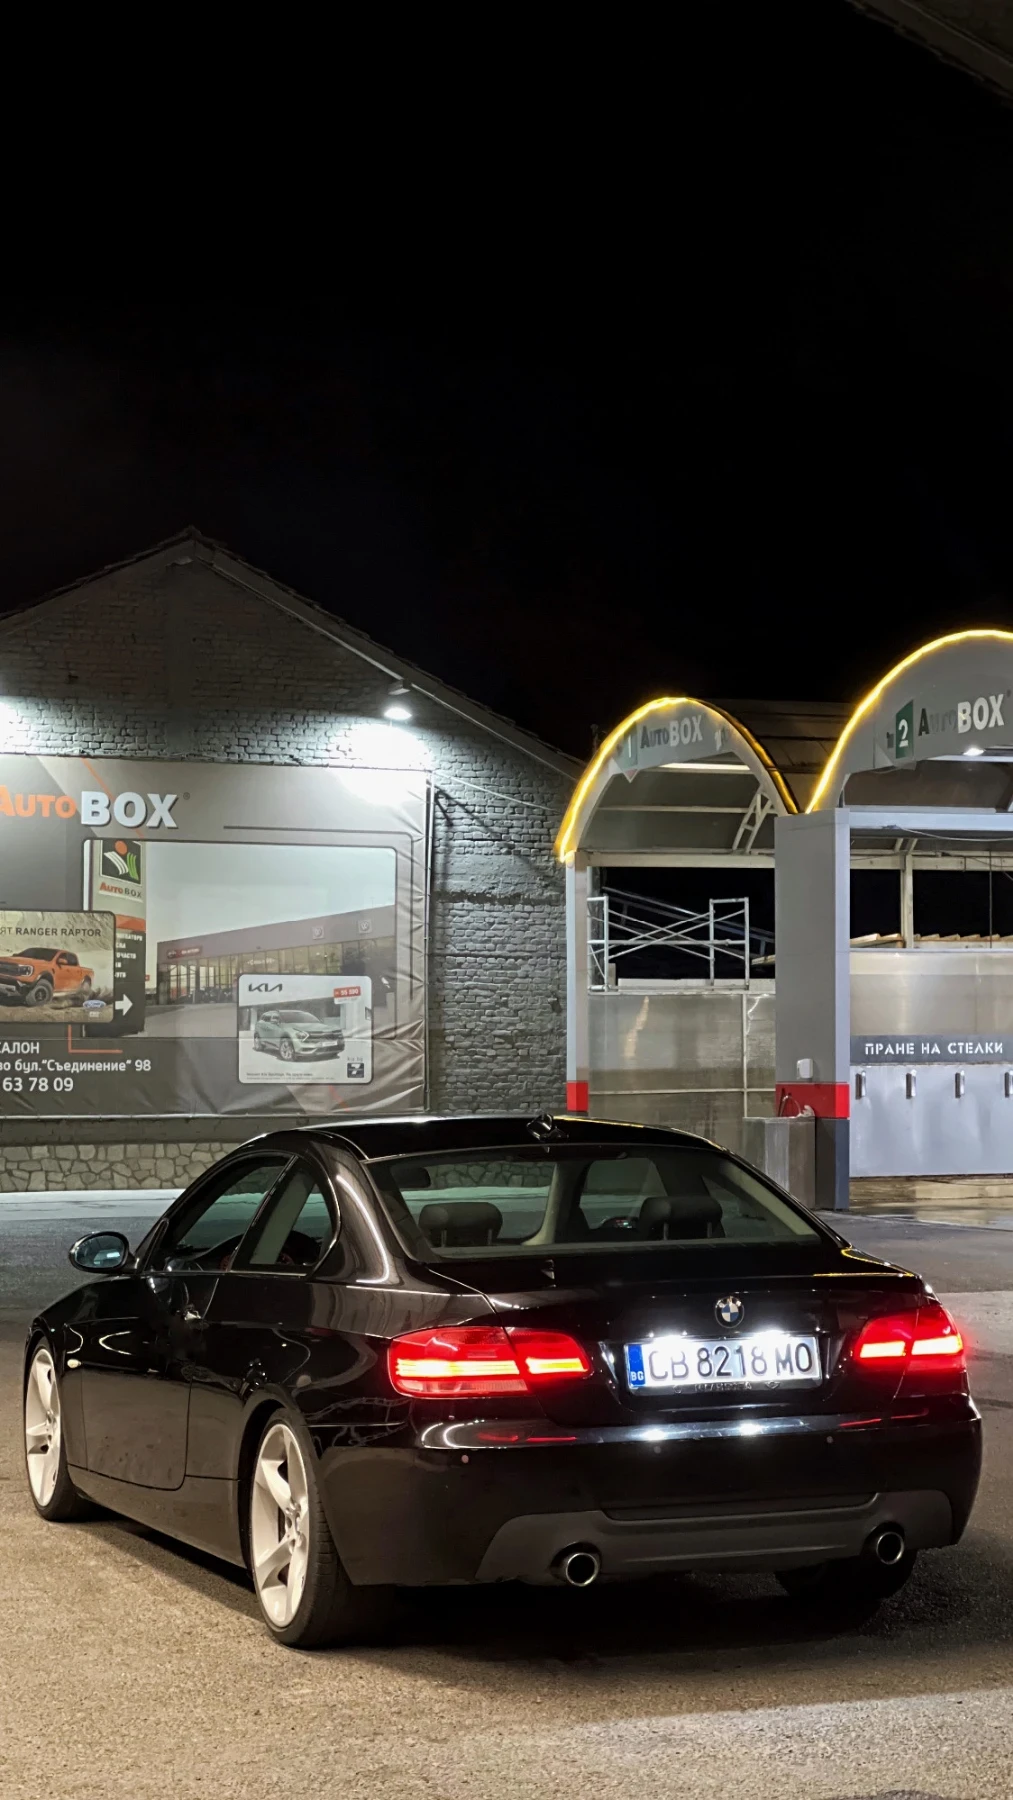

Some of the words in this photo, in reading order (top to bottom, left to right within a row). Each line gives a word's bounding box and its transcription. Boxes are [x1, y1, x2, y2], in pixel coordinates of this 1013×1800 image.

[898, 718, 909, 748] 2
[15, 927, 58, 936] RANGER
[60, 928, 102, 937] RAPTOR
[248, 983, 283, 992] KIA
[0, 1041, 40, 1054] АЛОН
[865, 1043, 915, 1055] ПРАНЕ
[921, 1043, 941, 1054] НА
[947, 1042, 1003, 1054] СТЕЛКИ
[134, 1060, 151, 1071] 98
[2, 1077, 23, 1092] 63
[28, 1077, 49, 1092] 78
[53, 1077, 74, 1092] 09
[648, 1349, 690, 1382] CB
[697, 1345, 768, 1377] 8218
[775, 1343, 813, 1375] MO
[631, 1371, 644, 1381] BG
